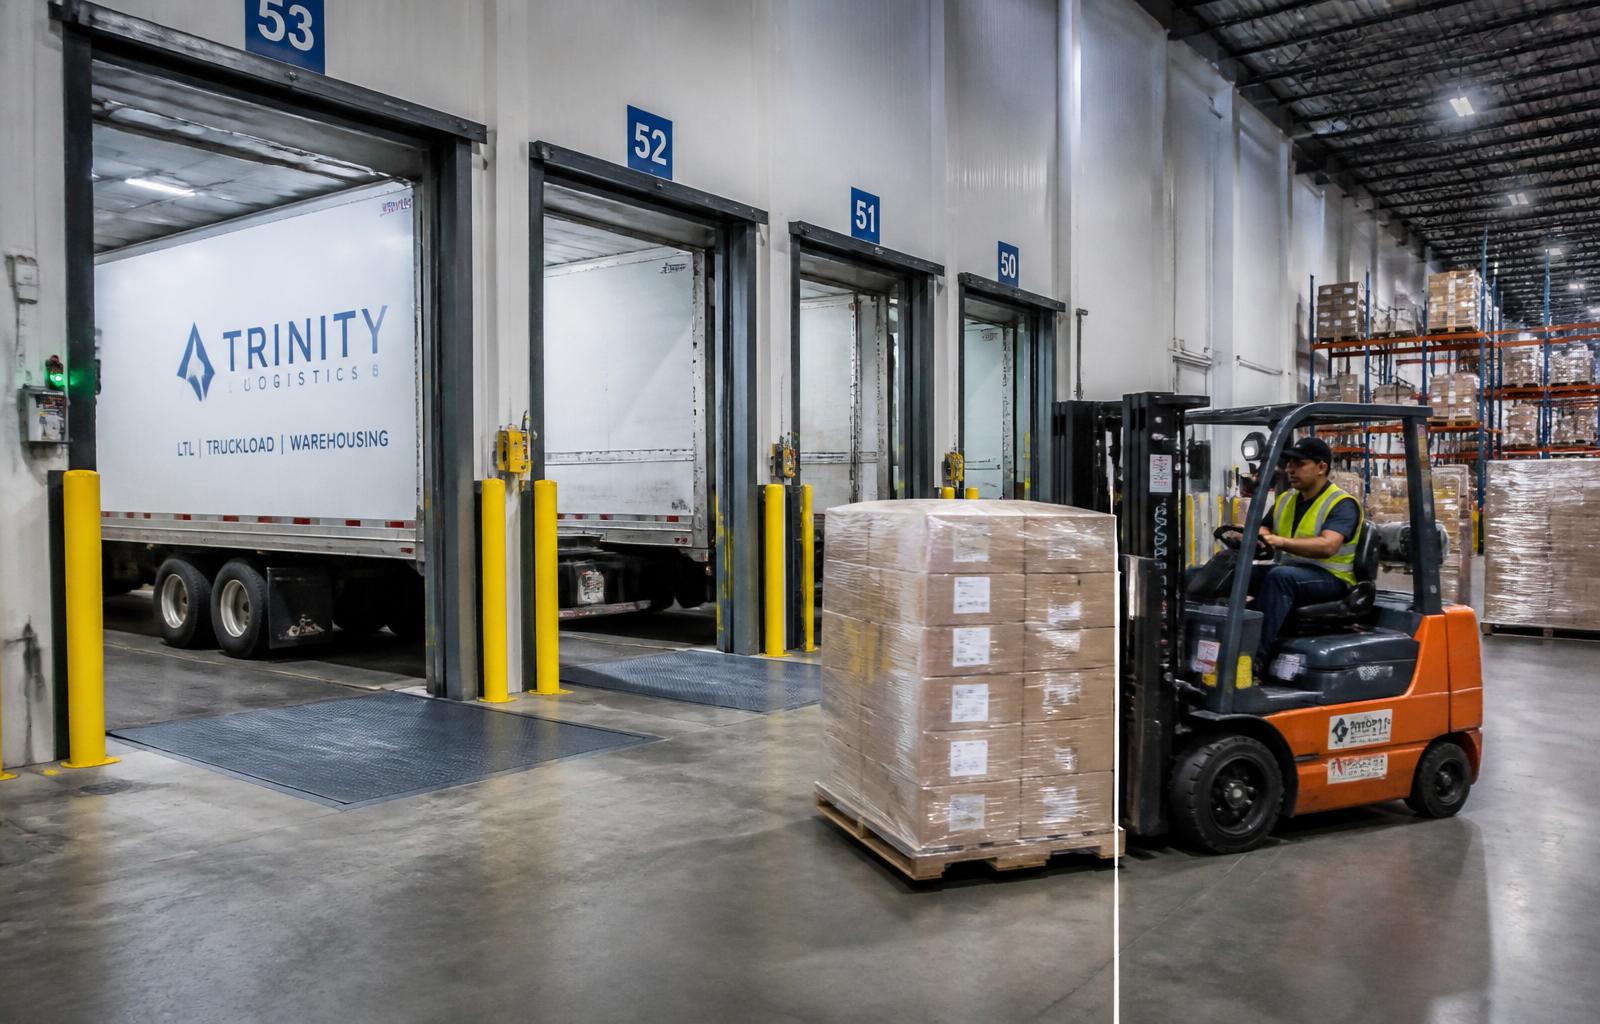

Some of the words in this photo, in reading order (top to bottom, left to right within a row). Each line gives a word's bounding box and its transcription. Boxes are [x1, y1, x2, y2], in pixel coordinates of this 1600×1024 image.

[257, 0, 315, 51] 53
[634, 122, 668, 166] 52
[855, 199, 876, 233] 51
[1000, 251, 1016, 279] 50
[222, 305, 388, 372] TRINITY
[177, 441, 195, 457] LTL
[206, 436, 275, 456] TRUCKLOAD
[289, 429, 389, 452] WAREHOUSING
